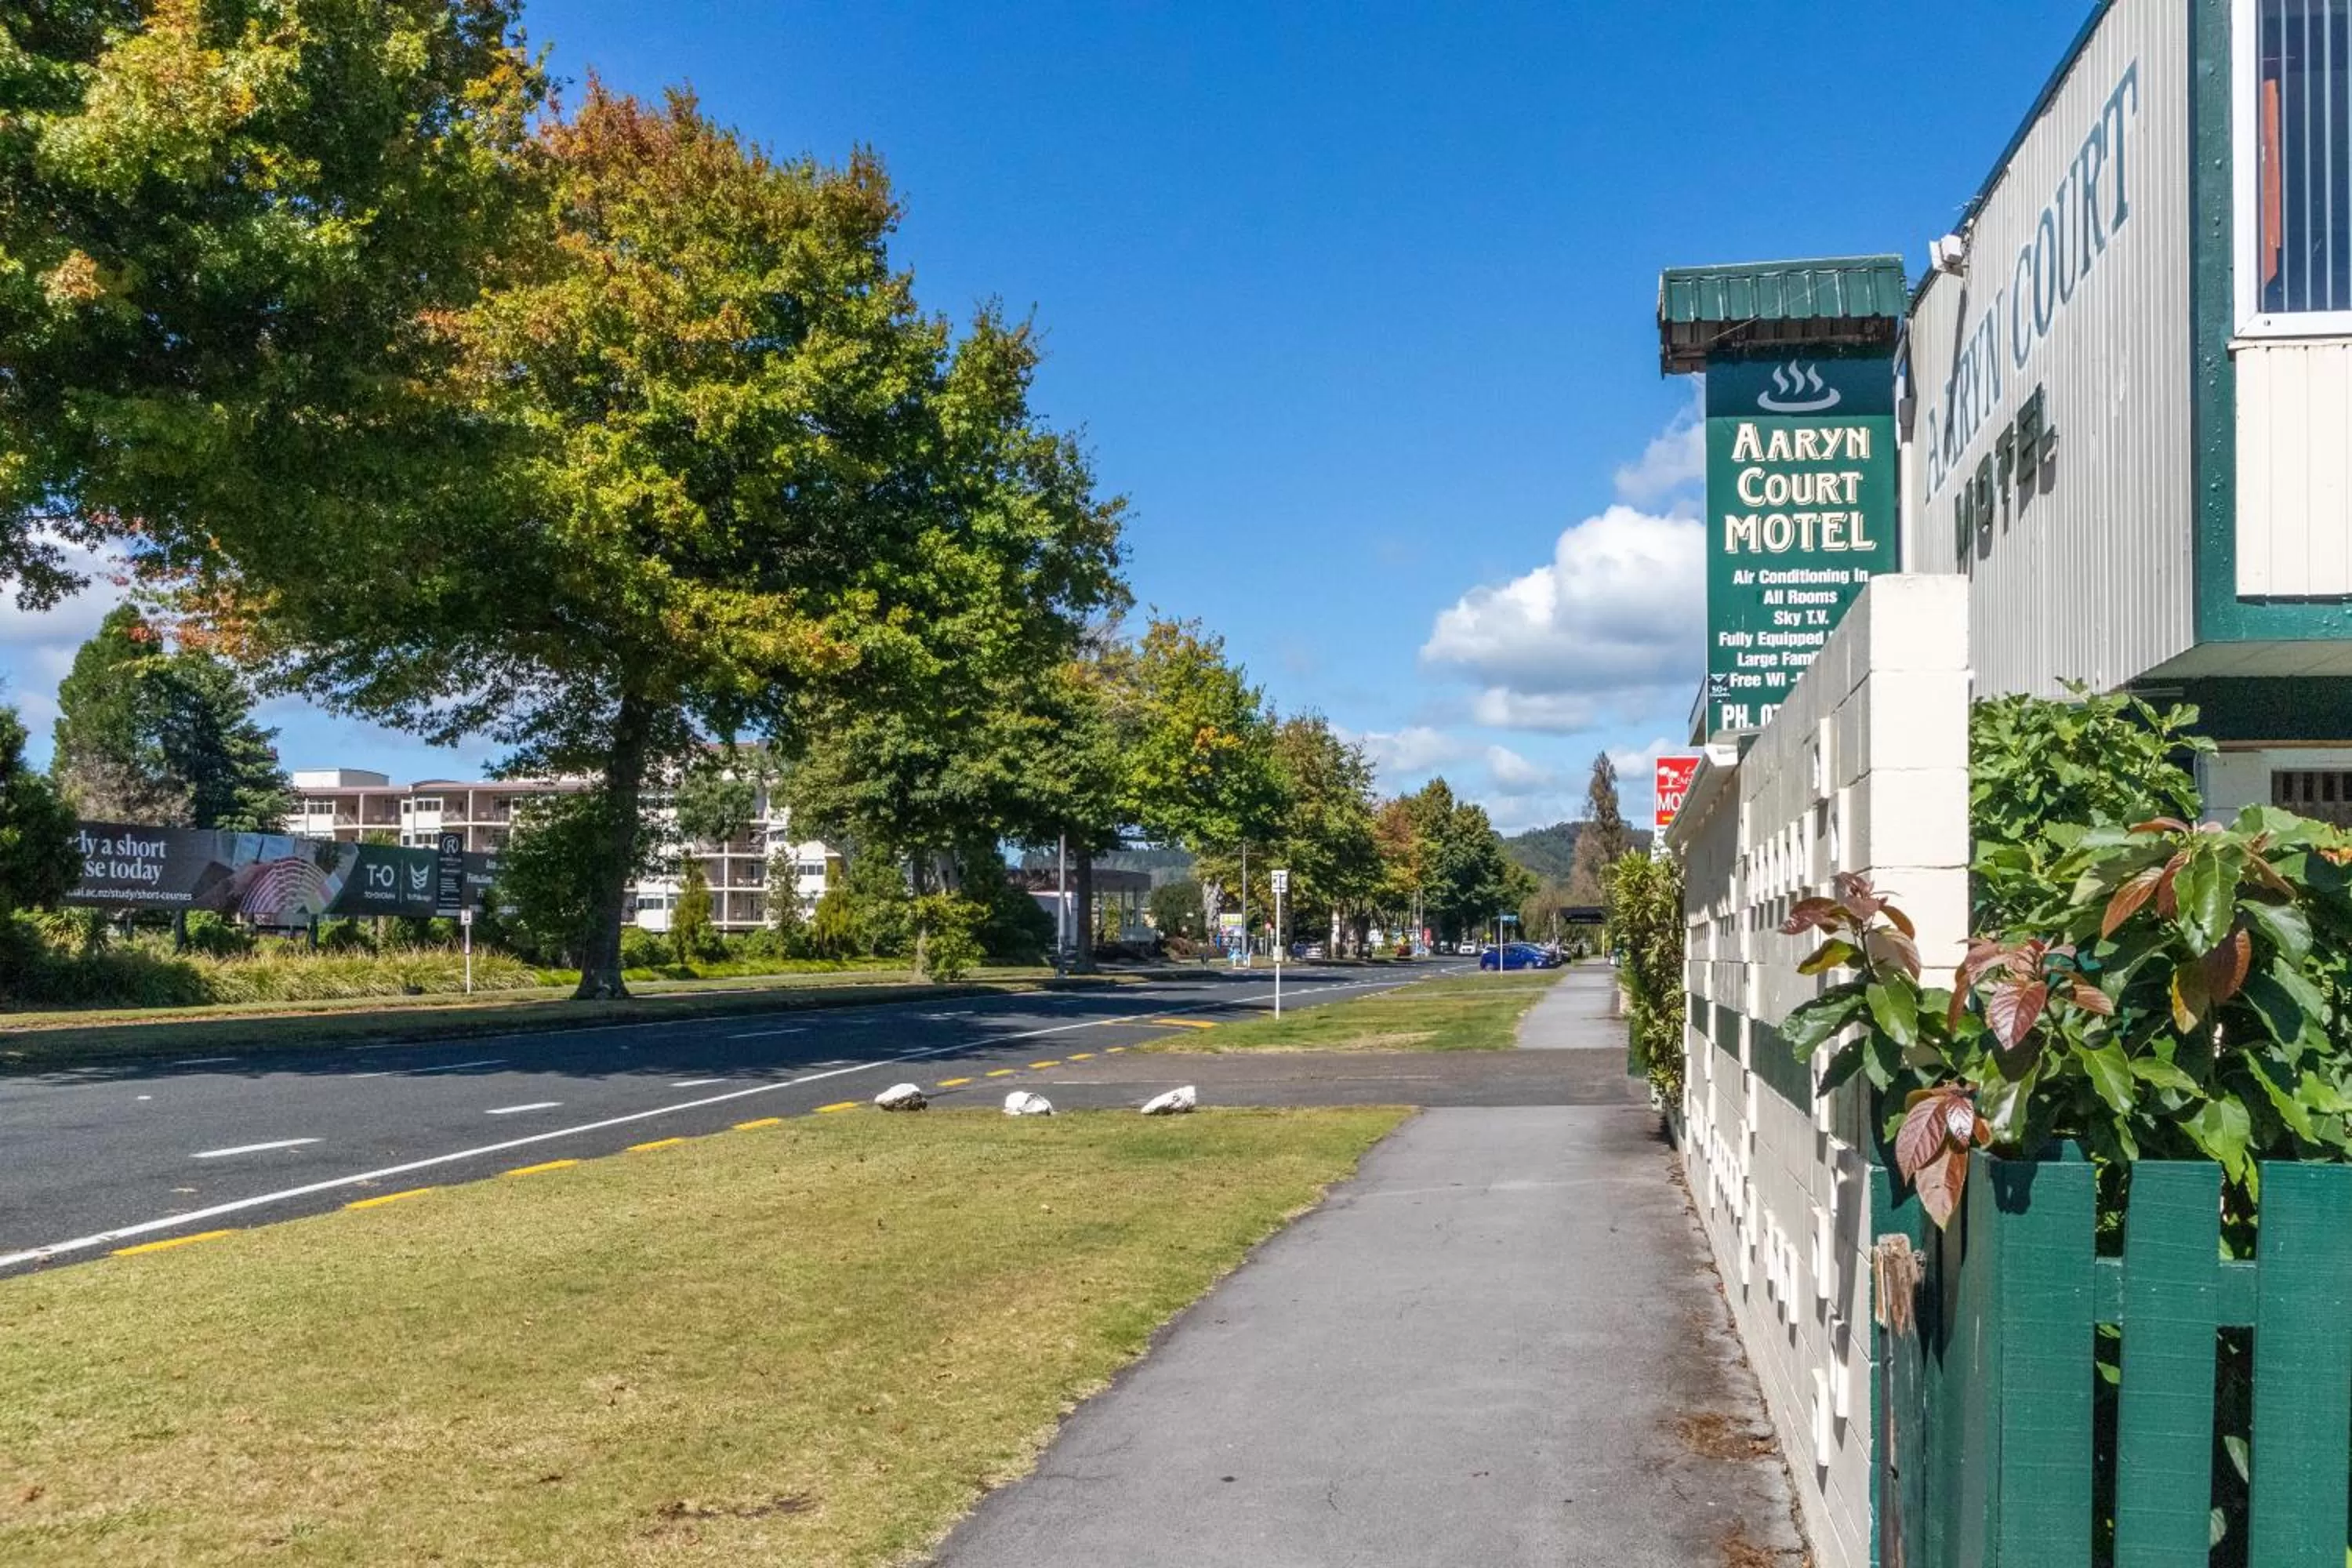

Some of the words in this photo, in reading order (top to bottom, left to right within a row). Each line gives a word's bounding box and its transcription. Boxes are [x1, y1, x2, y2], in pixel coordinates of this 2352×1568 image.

[1925, 287, 2004, 504] AARYN
[2010, 56, 2139, 374] COURT
[1731, 422, 1871, 462] AARYN
[1737, 466, 1864, 506] COURT
[1724, 511, 1877, 554] MOTEL
[1733, 569, 1755, 584] Air
[1759, 568, 1849, 585] Conditioning
[1853, 568, 1869, 583] In
[1763, 590, 1784, 604] All
[1787, 590, 1838, 604] Rooms
[1773, 610, 1802, 626] Sky
[1806, 609, 1829, 625] T.V.
[1719, 631, 1753, 648] Fully
[1758, 630, 1824, 648] Equipped
[1737, 652, 1778, 668] Large
[1782, 650, 1820, 666] Fami
[1730, 673, 1762, 688] Free
[1766, 672, 1787, 687] Wi
[1722, 704, 1754, 729] PH.
[1657, 791, 1686, 811] MO
[101, 837, 112, 855] a
[117, 833, 168, 858] short
[110, 858, 163, 886] today
